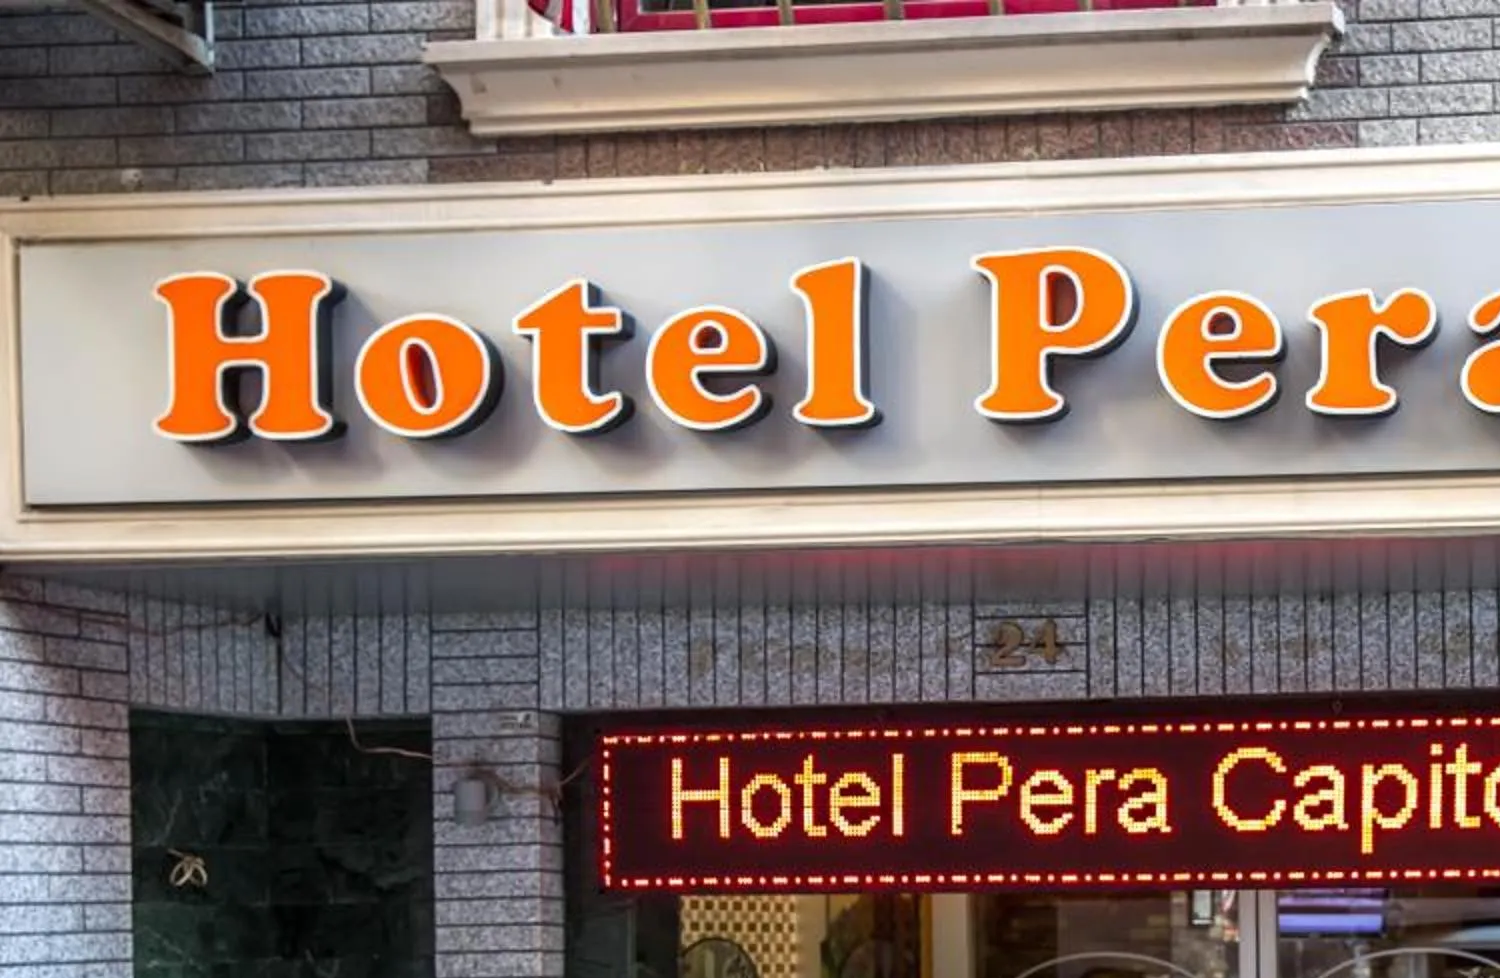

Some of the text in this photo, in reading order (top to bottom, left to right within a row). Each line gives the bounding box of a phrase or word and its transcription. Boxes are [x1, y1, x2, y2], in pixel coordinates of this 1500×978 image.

[154, 258, 872, 440] Hotel
[989, 620, 1062, 667] 24
[670, 752, 905, 840] Hotel
[950, 751, 1173, 837] Pera
